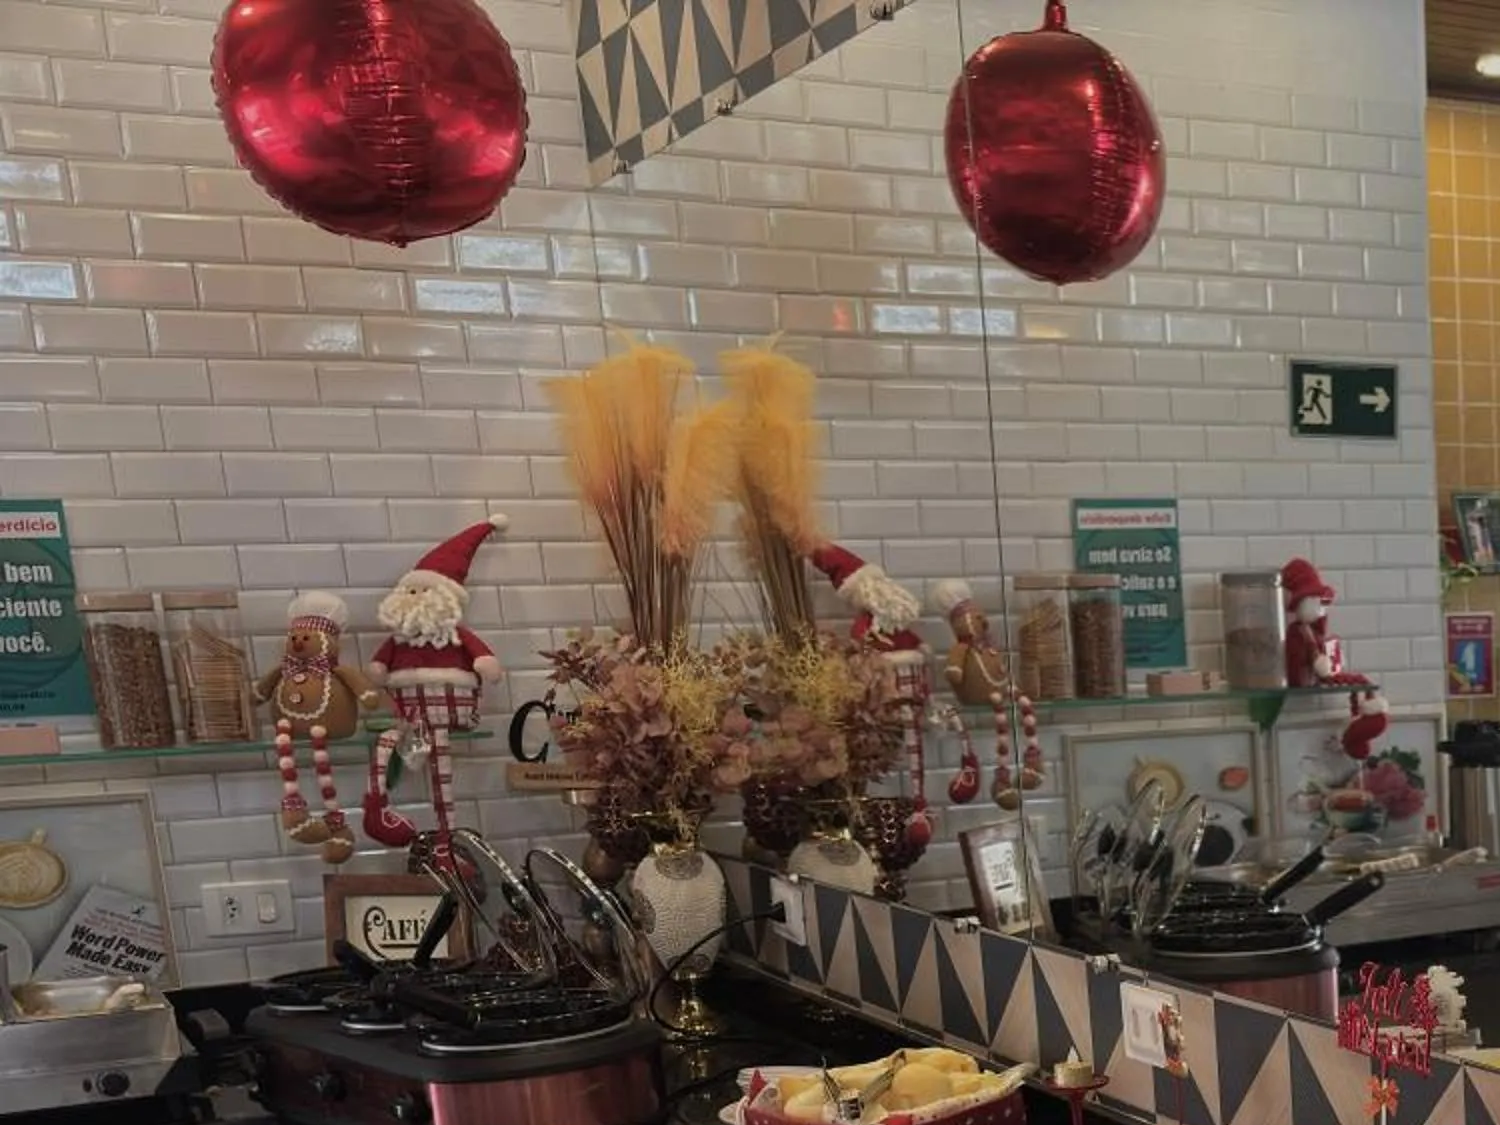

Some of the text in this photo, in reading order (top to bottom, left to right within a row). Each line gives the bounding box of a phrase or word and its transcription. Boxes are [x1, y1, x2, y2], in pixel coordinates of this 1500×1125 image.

[3, 561, 54, 583] bem
[65, 941, 113, 966] Made
[70, 924, 118, 951] Word
[114, 936, 167, 963] Power
